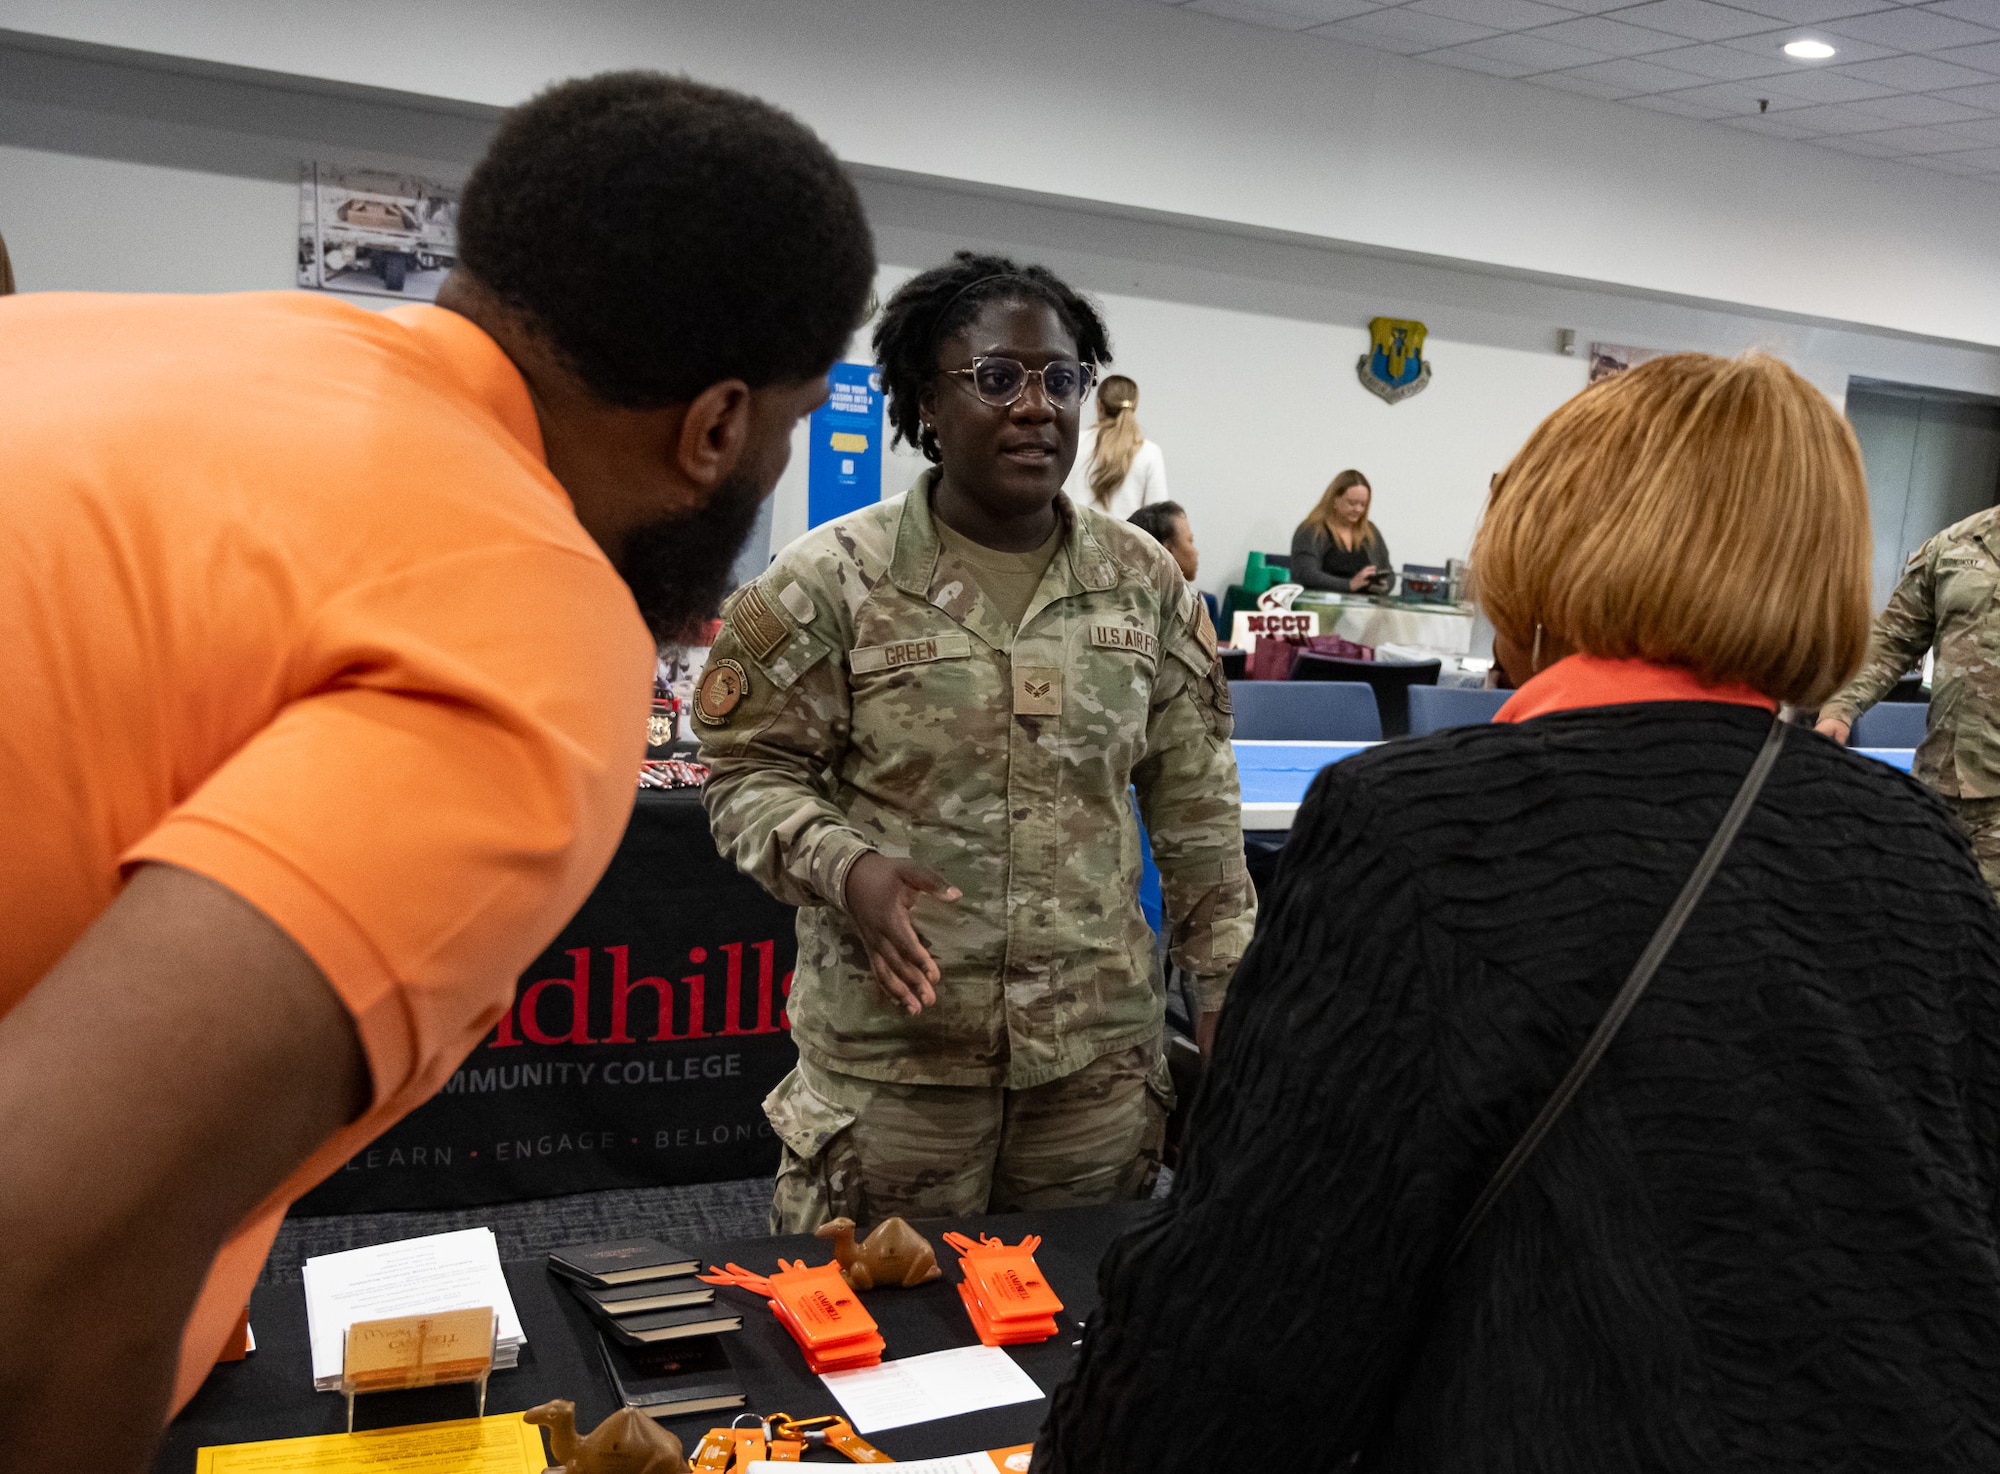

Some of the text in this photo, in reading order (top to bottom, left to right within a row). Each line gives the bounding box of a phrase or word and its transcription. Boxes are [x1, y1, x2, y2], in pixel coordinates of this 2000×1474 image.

[885, 640, 937, 665] GREEN
[602, 1053, 742, 1084] COLLEGE
[496, 1131, 615, 1161] ENGAGE
[1007, 1269, 1030, 1299] CAMPBELL
[814, 1290, 842, 1321] CAMPBELL
